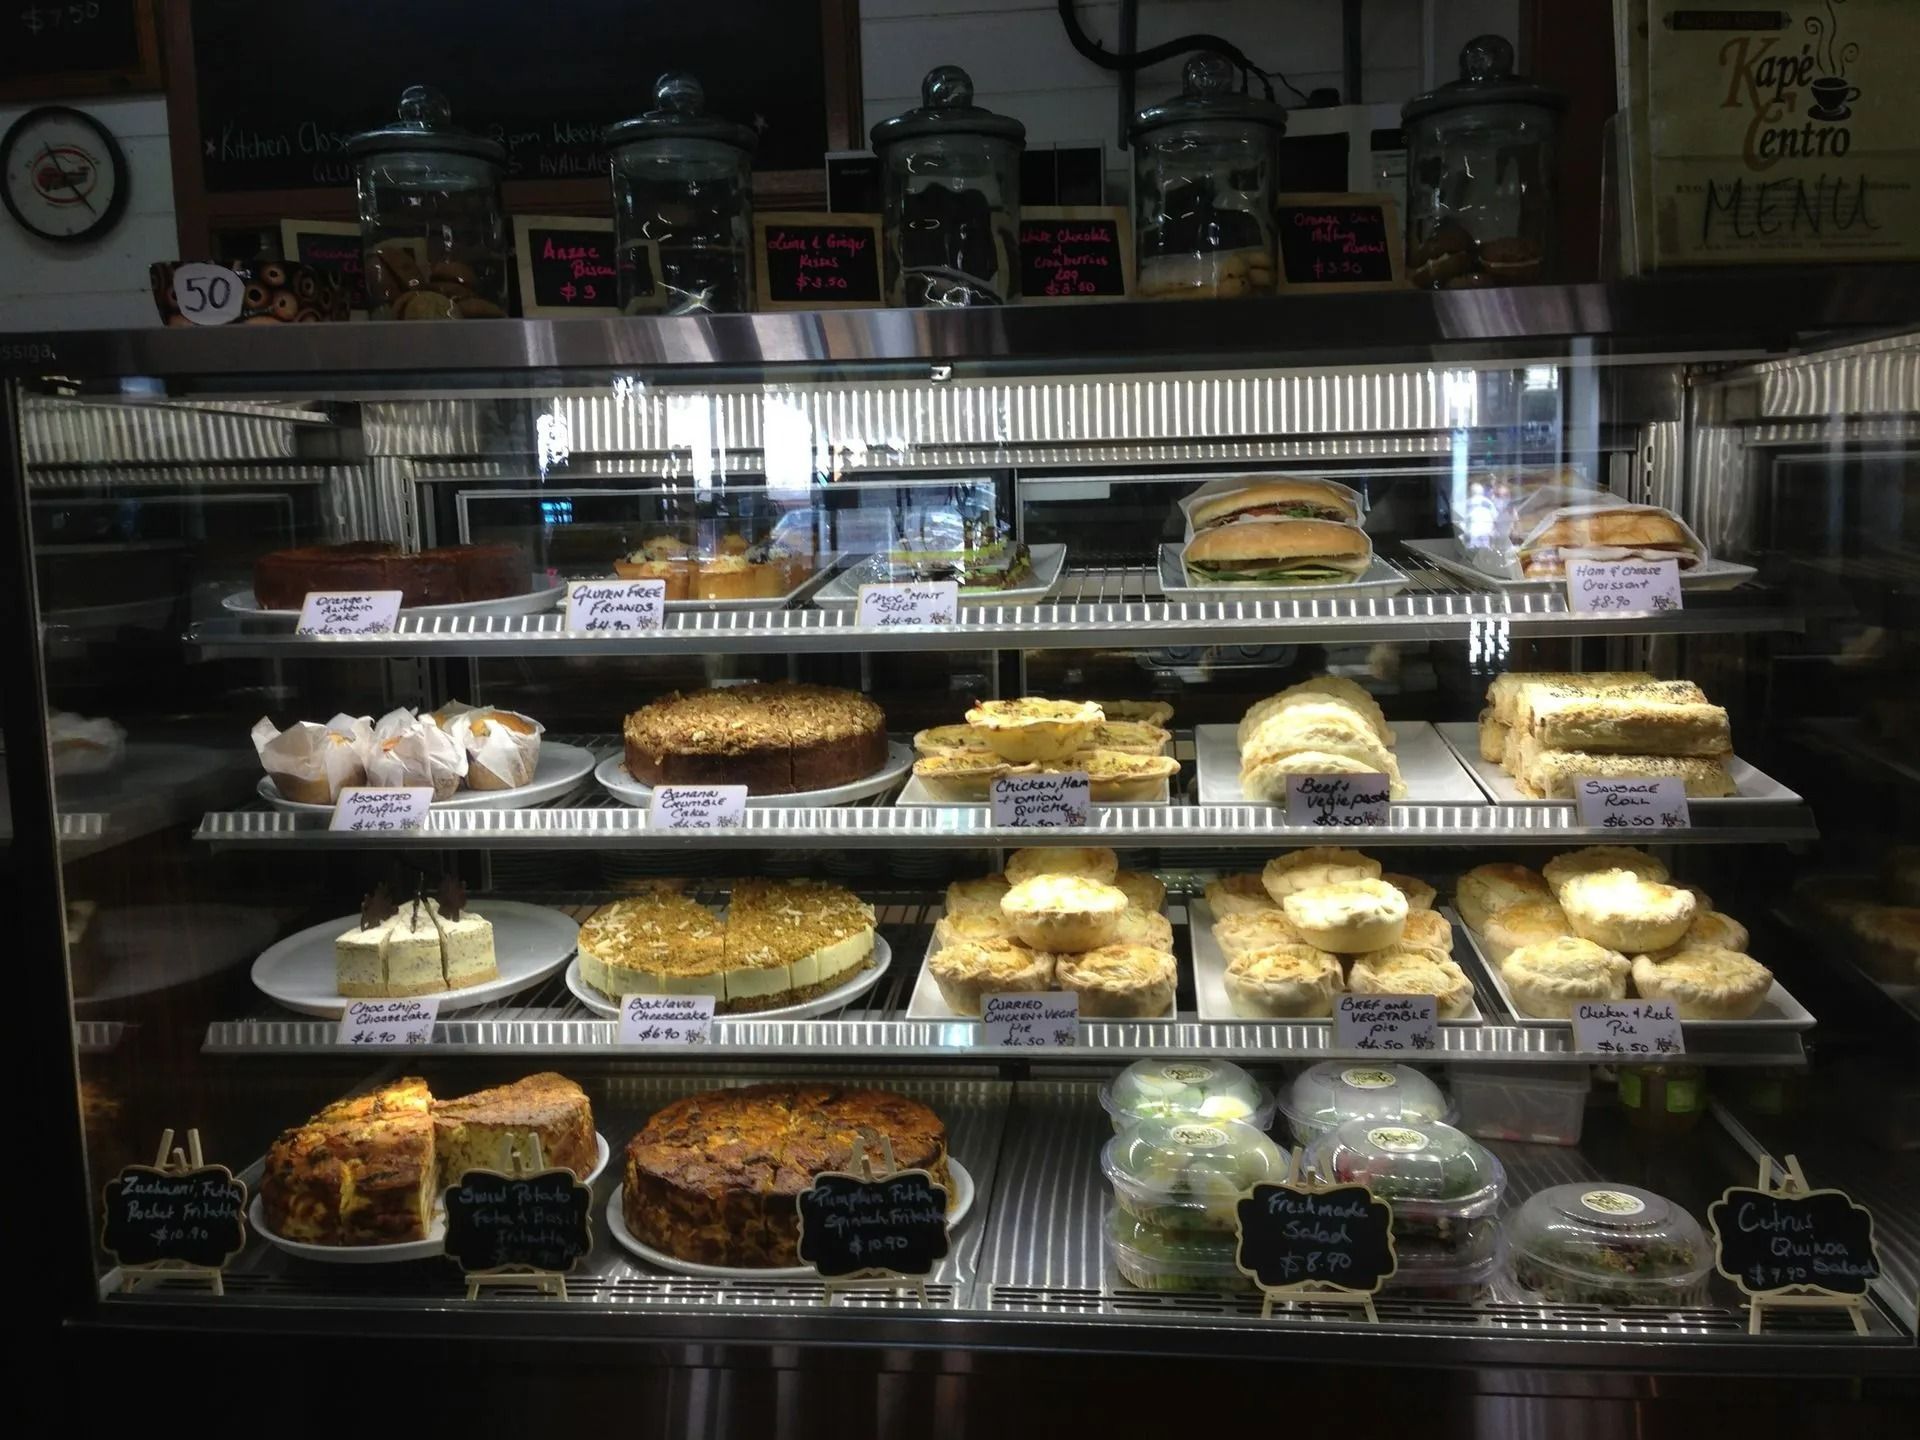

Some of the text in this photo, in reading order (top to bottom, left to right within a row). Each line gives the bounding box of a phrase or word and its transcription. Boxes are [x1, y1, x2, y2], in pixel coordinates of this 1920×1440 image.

[222, 119, 291, 161] Kitchen
[1743, 92, 1851, 172] Centro
[1703, 173, 1882, 248] MENU
[185, 277, 231, 312] 50
[1576, 565, 1605, 576] Ham
[627, 584, 663, 598] FREE
[1282, 1220, 1353, 1244] Salad
[1279, 1250, 1352, 1279] $8.90
